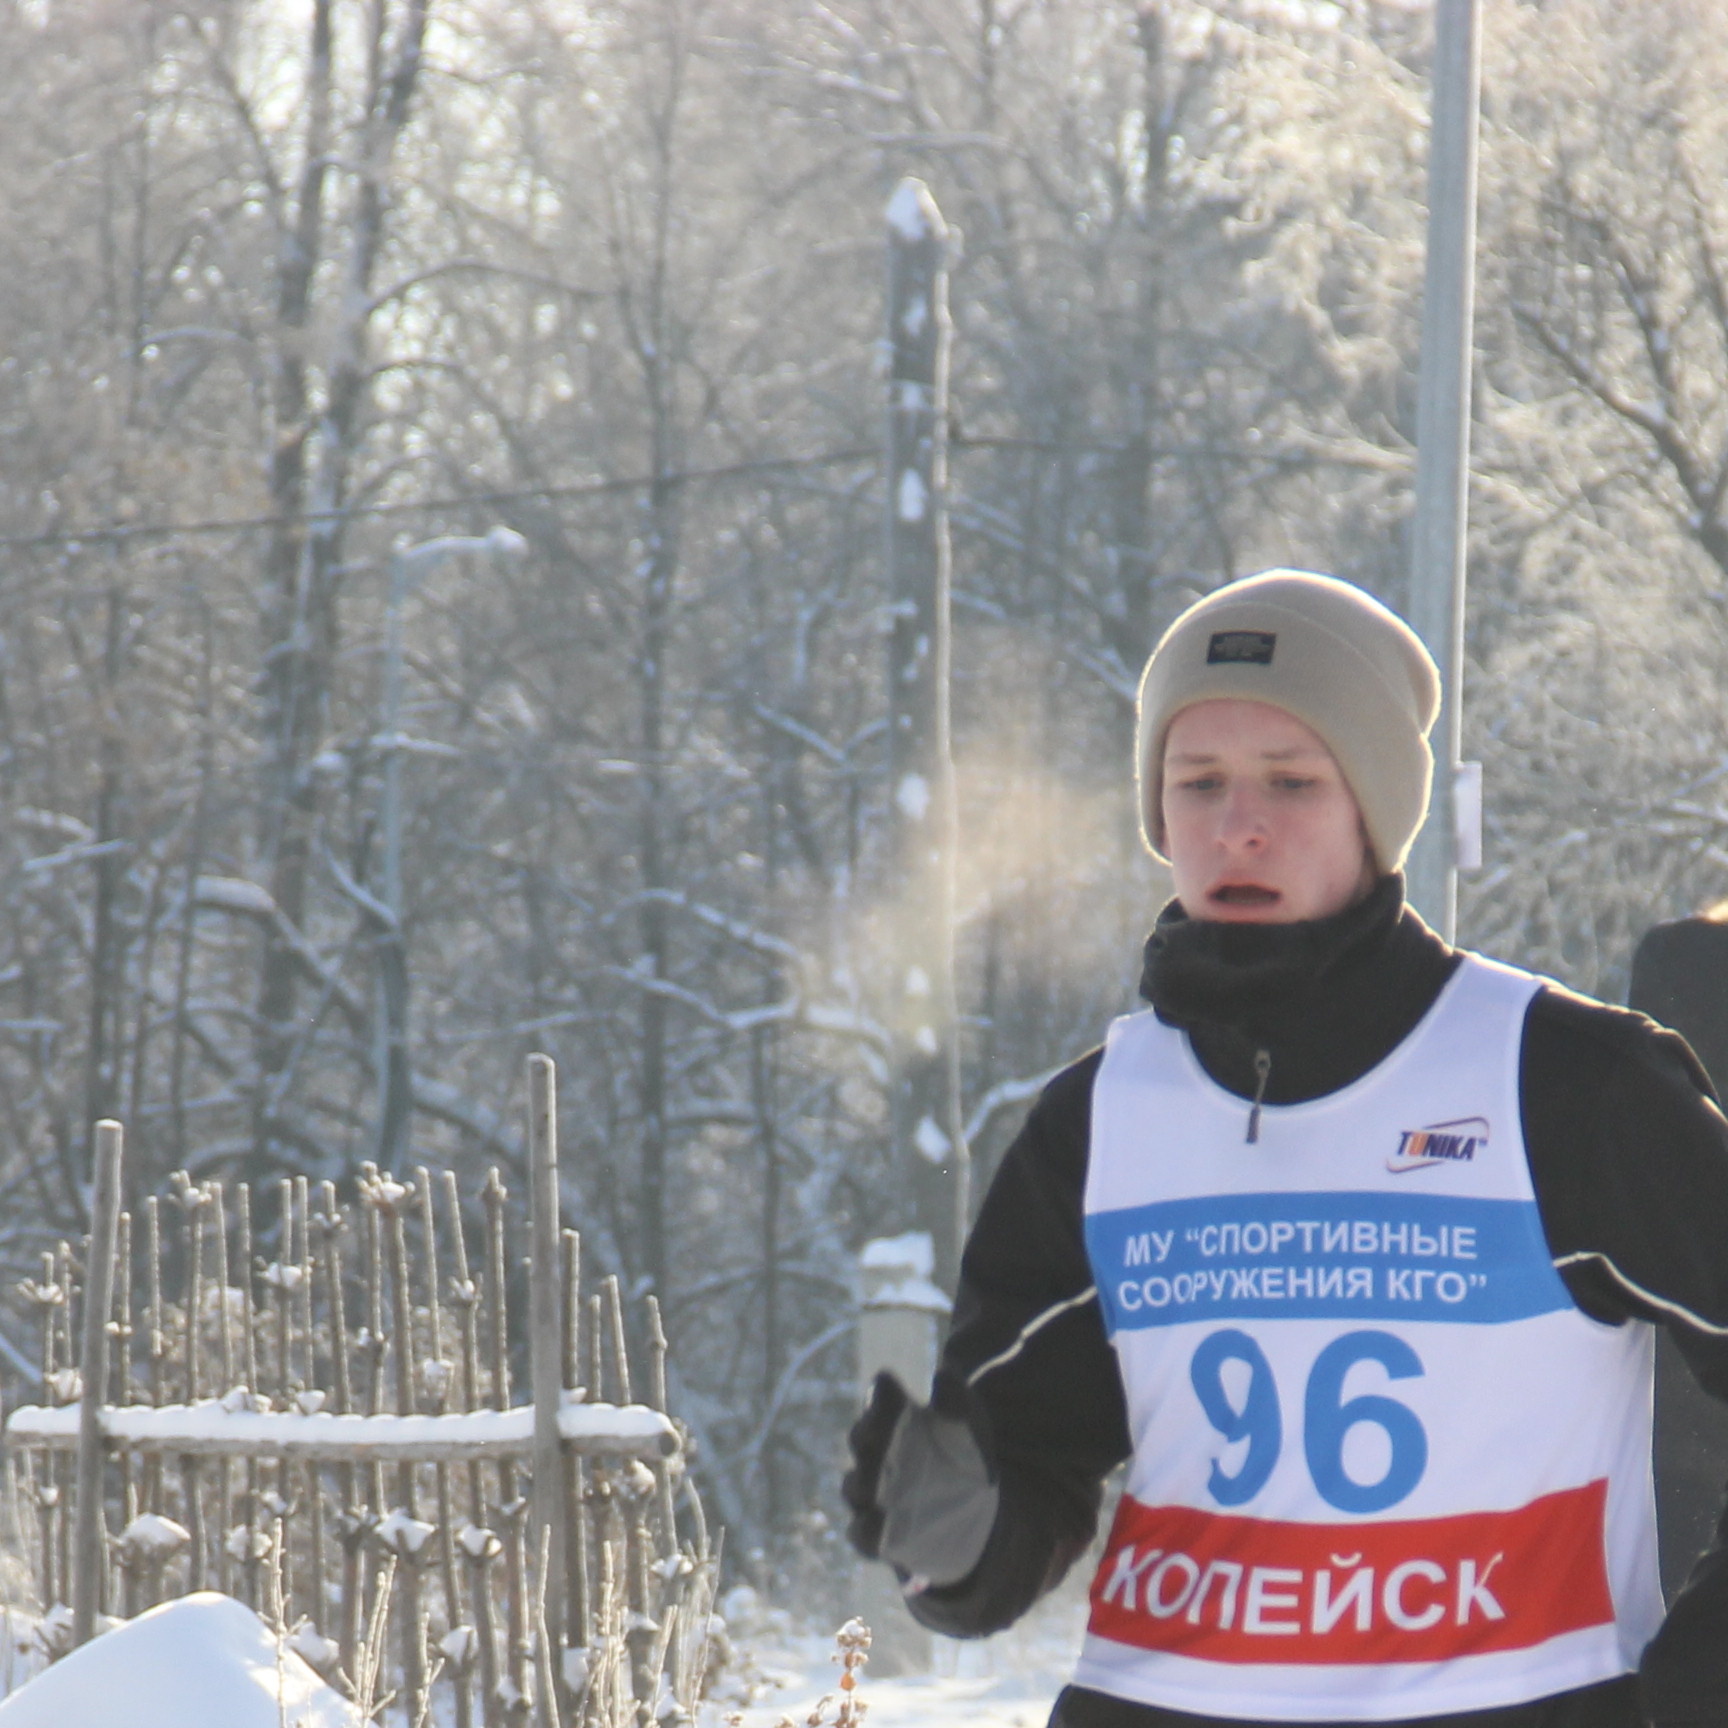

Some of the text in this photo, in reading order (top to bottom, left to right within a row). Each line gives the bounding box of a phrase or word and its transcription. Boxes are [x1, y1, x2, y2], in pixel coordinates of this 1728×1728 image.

[1124, 1230, 1174, 1267] МУ
[1117, 1266, 1373, 1311] СООРУЖЕНИЯ
[1190, 1328, 1429, 1515] 96
[1101, 1544, 1506, 1634] КОПЕЙСК
